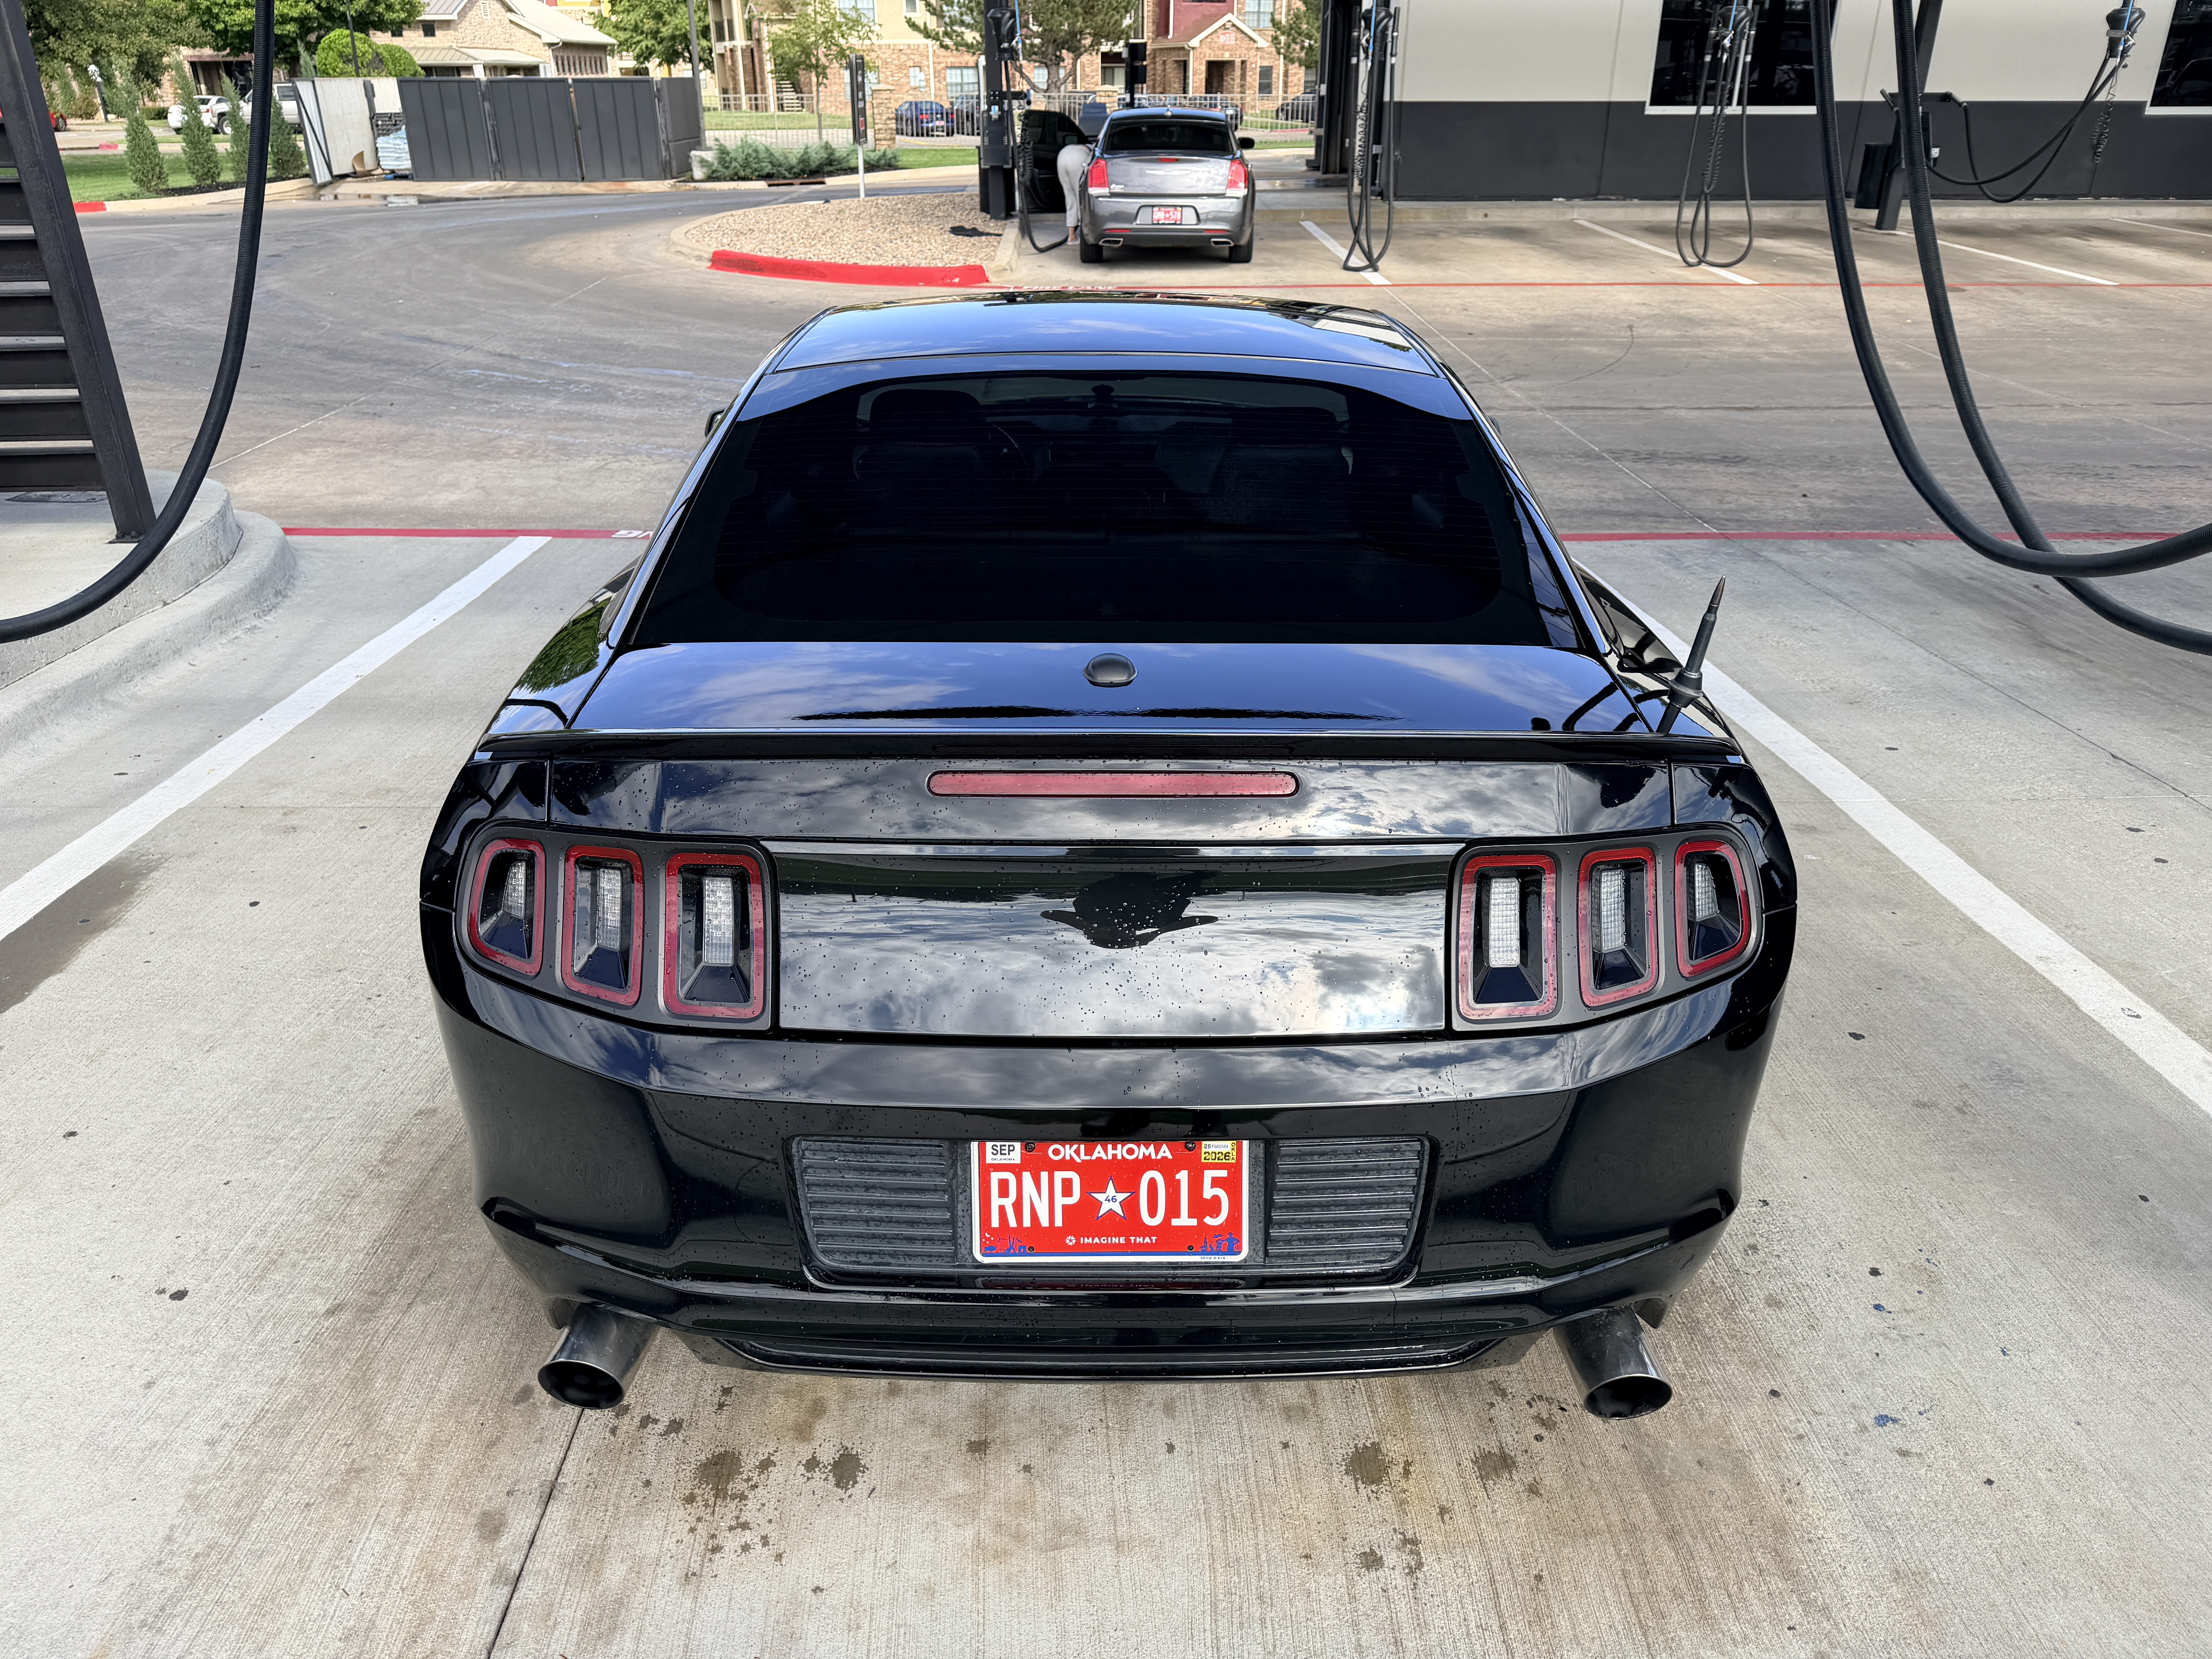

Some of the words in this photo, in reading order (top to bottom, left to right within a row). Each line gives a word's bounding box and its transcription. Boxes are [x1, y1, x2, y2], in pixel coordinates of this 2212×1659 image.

[991, 1144, 1015, 1156] SEP
[1048, 1143, 1173, 1163] OKLAHOMA
[1204, 1151, 1231, 1161] 2026
[990, 1171, 1081, 1228] RNP
[1139, 1170, 1229, 1226] 015
